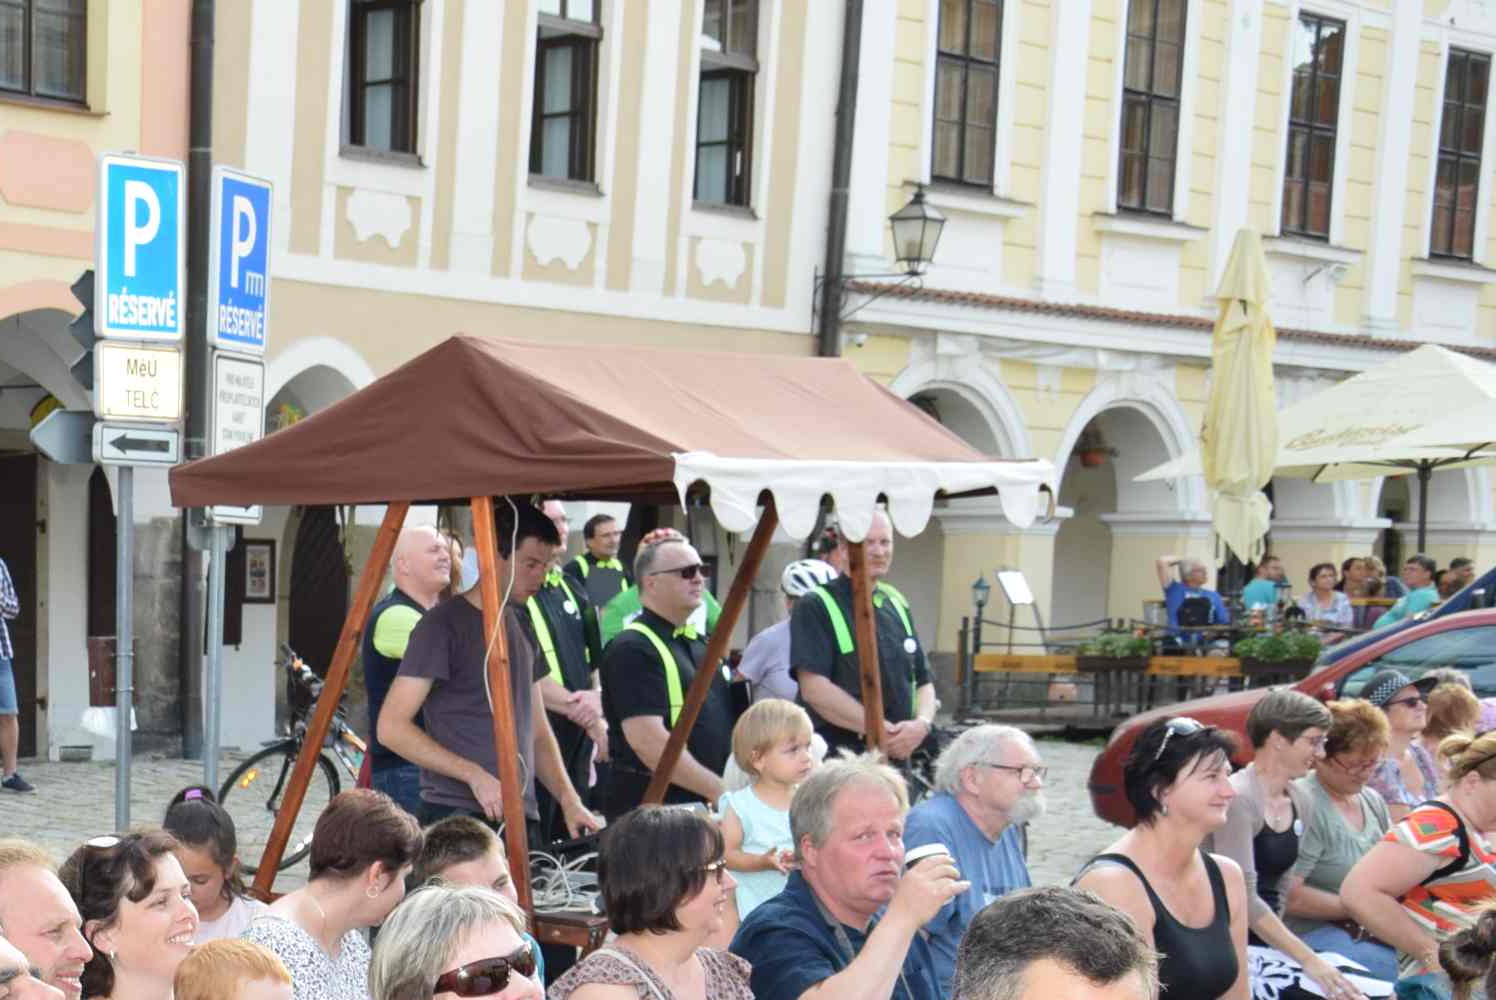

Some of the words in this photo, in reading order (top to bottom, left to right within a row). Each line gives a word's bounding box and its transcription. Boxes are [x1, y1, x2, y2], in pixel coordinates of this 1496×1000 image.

[124, 179, 161, 278] P
[230, 194, 257, 289] P
[107, 287, 176, 328] RÉSERVÉ
[219, 298, 264, 340] RÉSERVÉ
